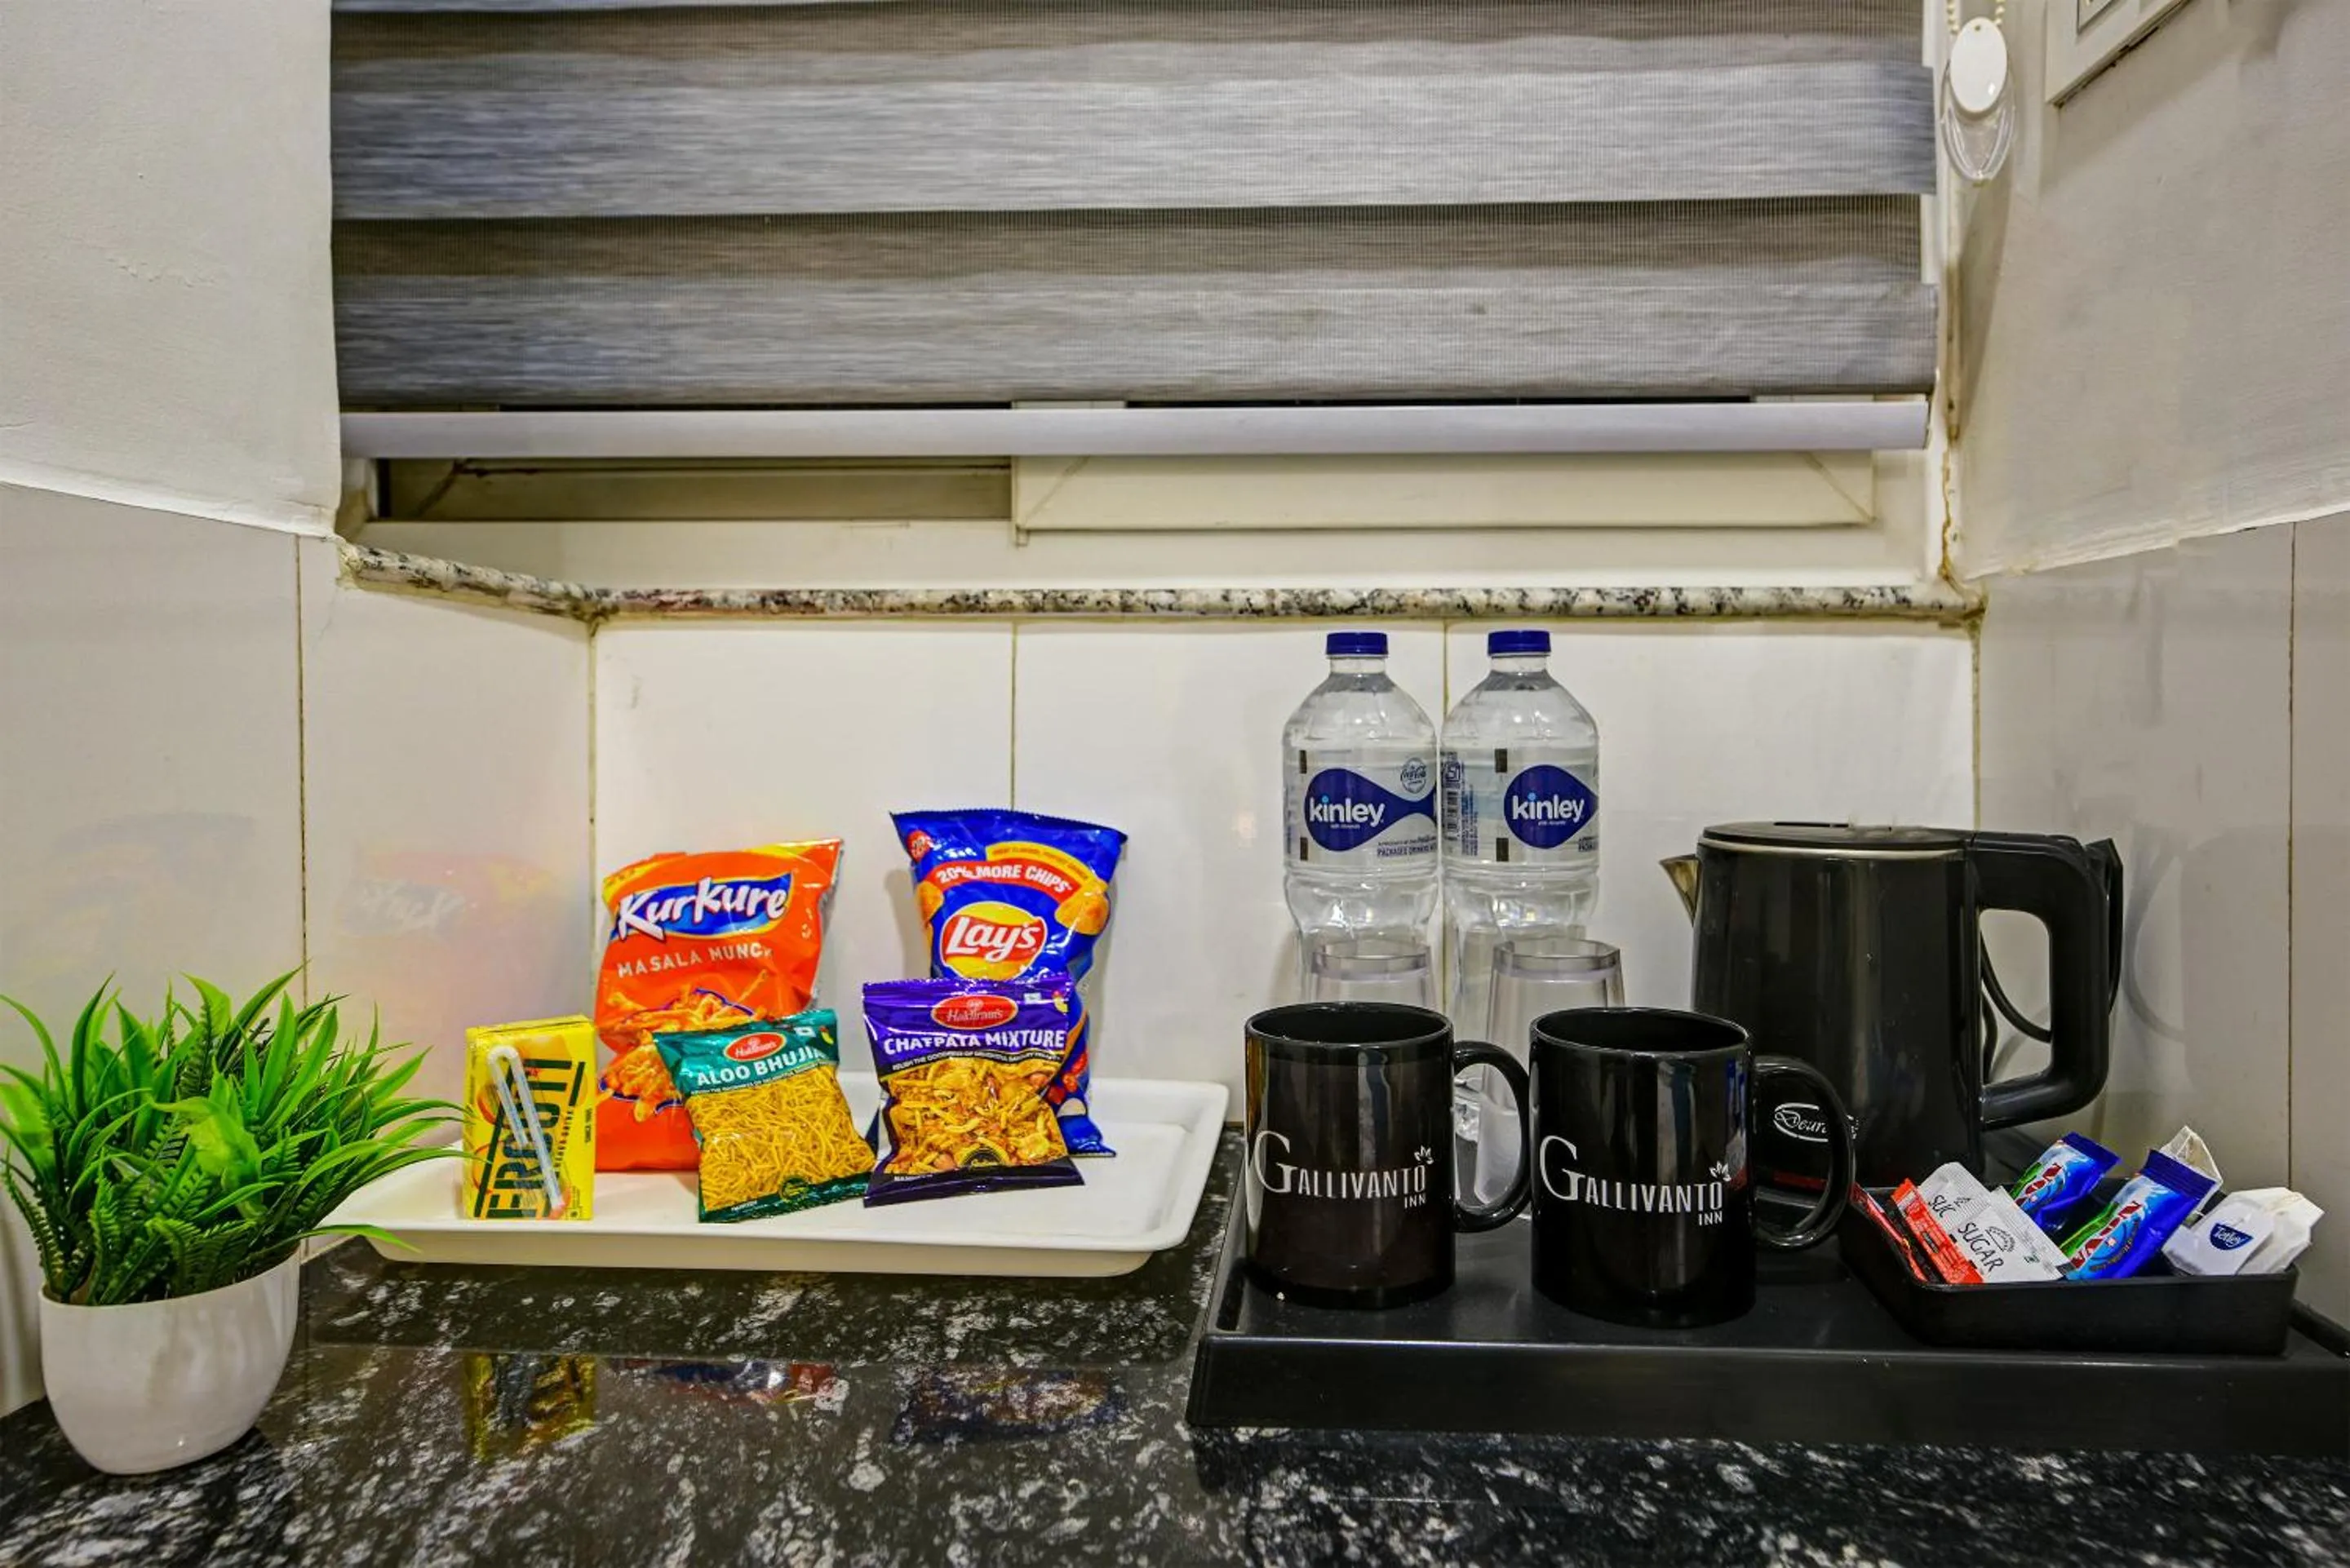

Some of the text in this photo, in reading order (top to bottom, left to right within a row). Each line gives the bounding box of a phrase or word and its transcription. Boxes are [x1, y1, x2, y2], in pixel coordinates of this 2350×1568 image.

[1309, 795, 1385, 827] kinley
[1512, 792, 1585, 822] kinley
[976, 864, 1022, 879] MORE
[1025, 865, 1070, 893] CHIPS
[617, 876, 788, 941] Kurkure
[946, 917, 1040, 963] Lay's
[617, 951, 703, 978] MASALA
[884, 1029, 1066, 1055] CHATPATA MIXTURE
[697, 1065, 751, 1087] ALOO
[754, 1047, 827, 1077] BHUJIA
[1254, 1130, 1426, 1199] GALLIVANTO
[1539, 1135, 1723, 1213] GALLIVANTO
[1404, 1194, 1426, 1208] INN
[1698, 1211, 1723, 1226] INN
[1958, 1222, 2004, 1272] SUGAR
